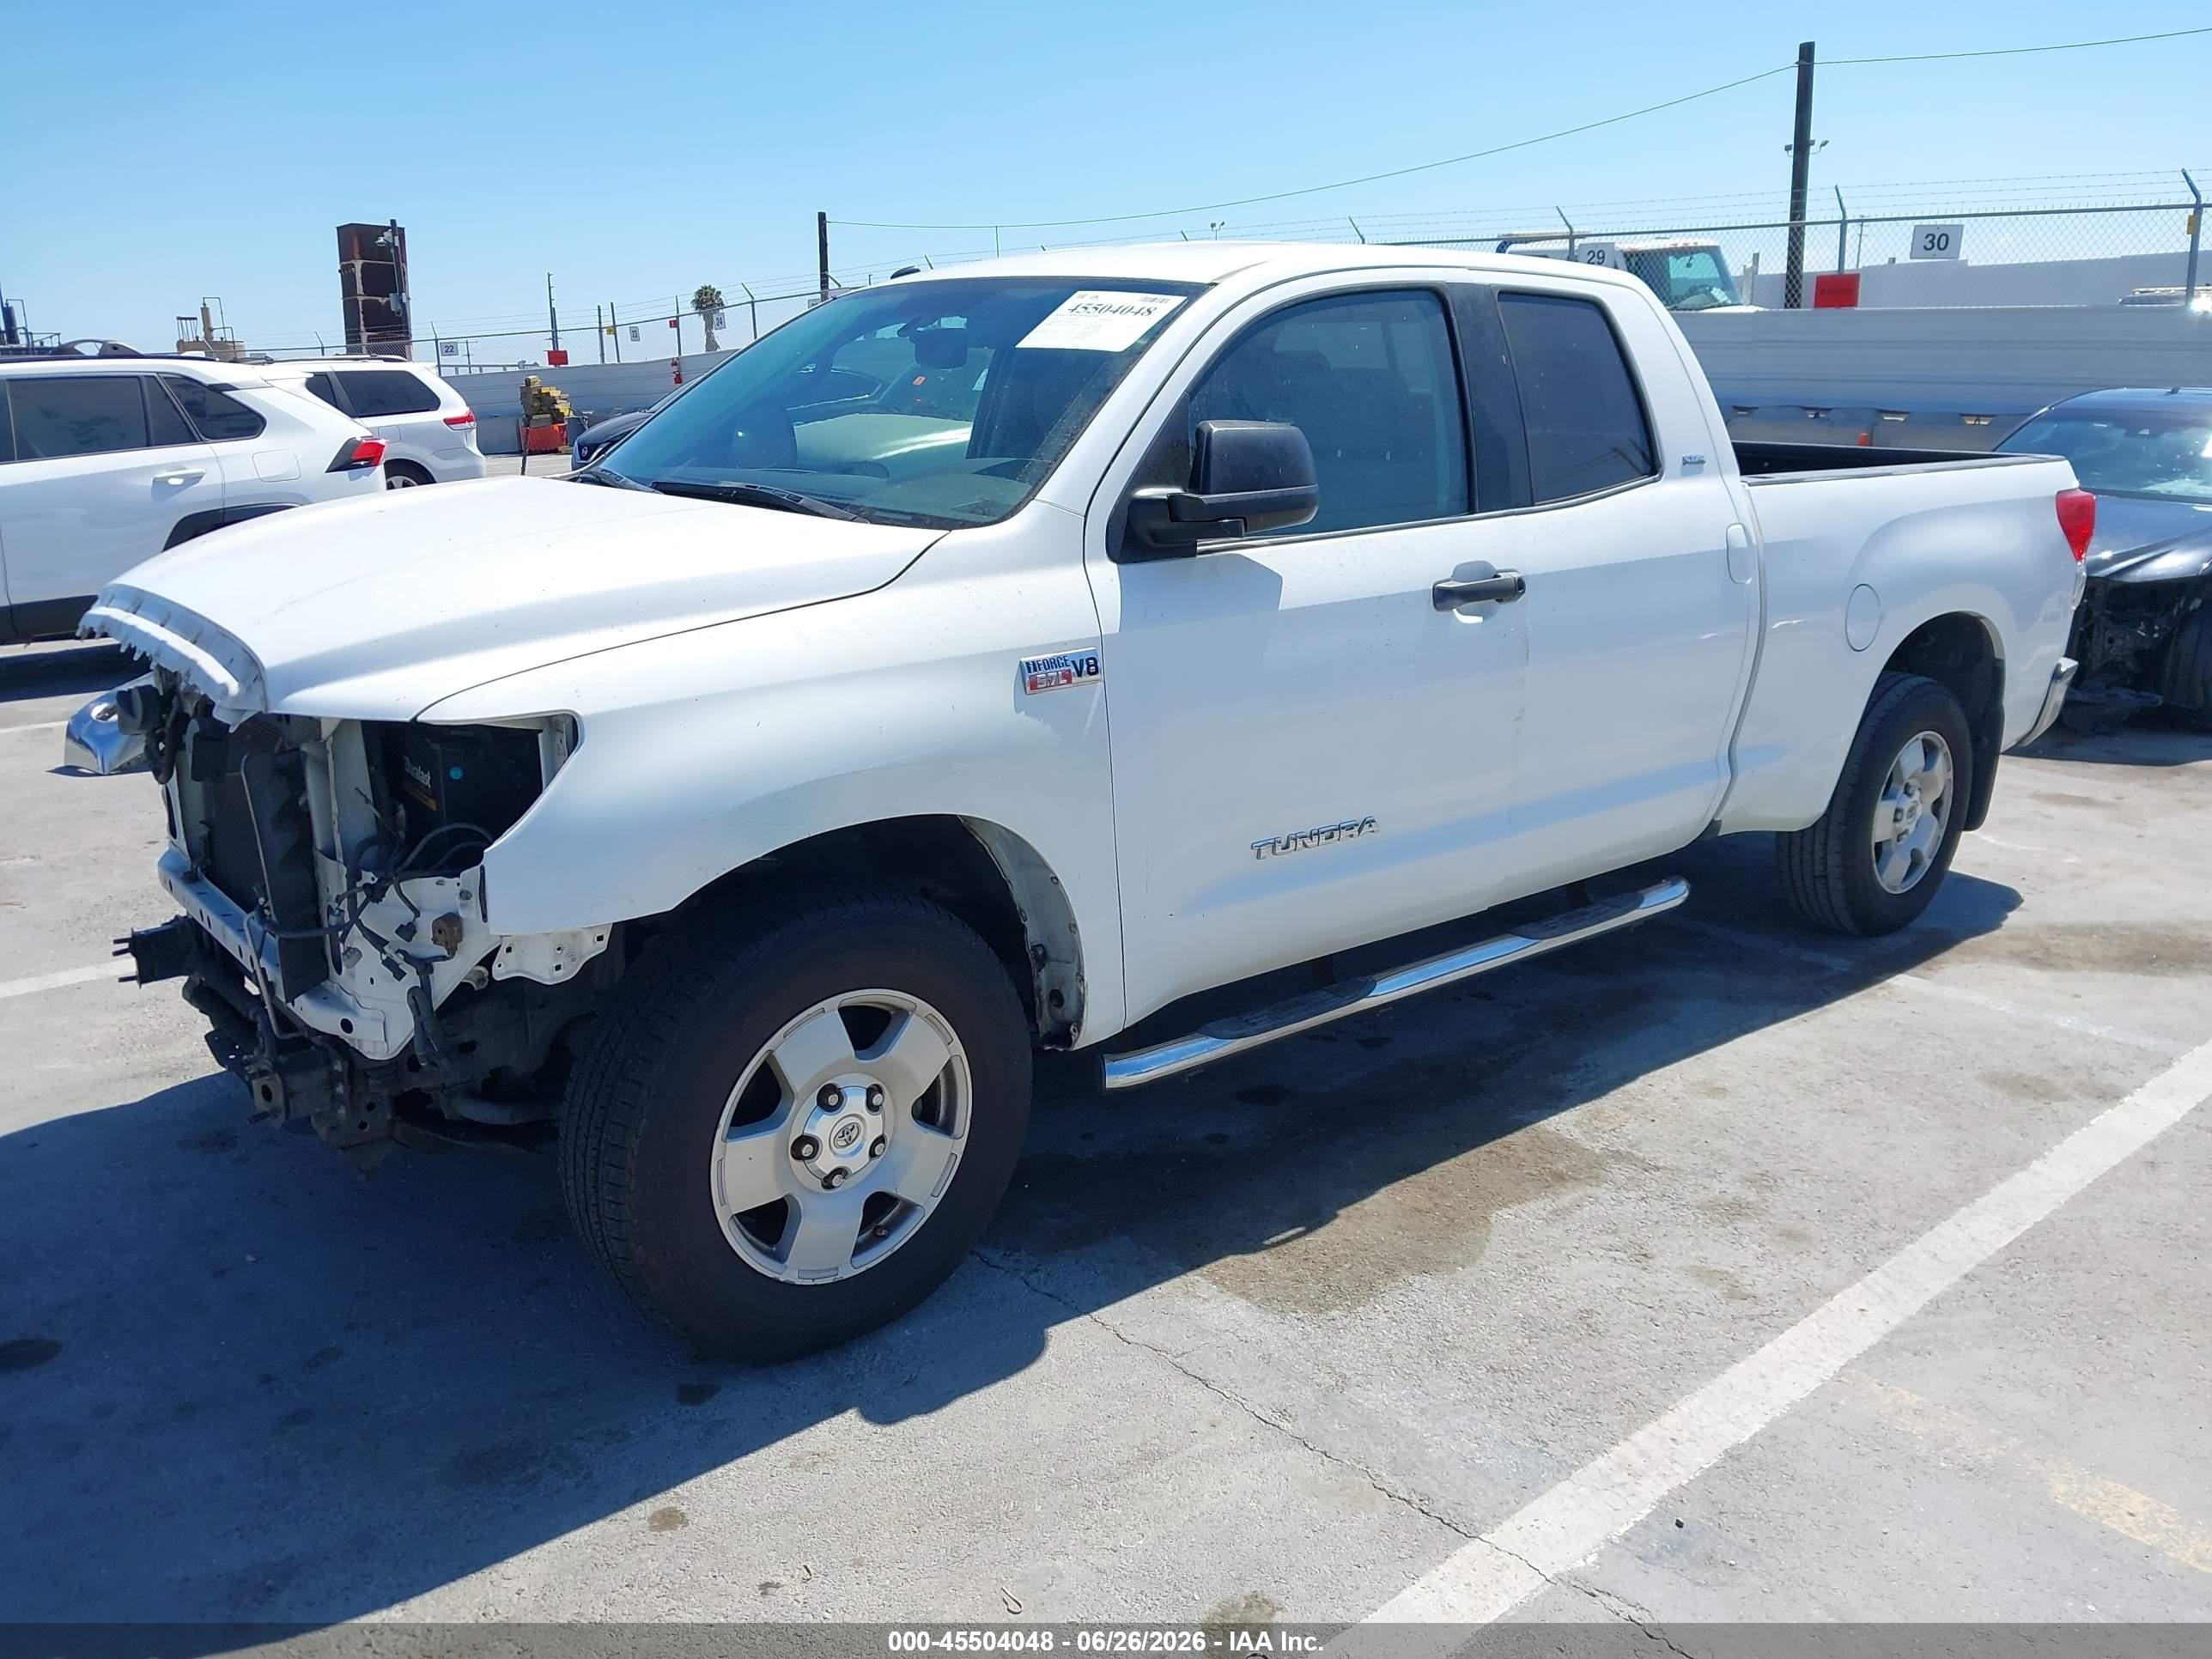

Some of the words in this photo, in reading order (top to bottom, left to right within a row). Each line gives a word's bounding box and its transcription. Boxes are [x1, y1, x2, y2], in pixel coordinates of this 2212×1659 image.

[1923, 233, 1949, 252] 30
[1587, 249, 1606, 265] 29
[1067, 302, 1158, 317] 45504048
[715, 317, 723, 326] 24
[444, 344, 454, 353] 22
[1071, 656, 1099, 678] V8
[1250, 816, 1380, 860] TUNDRA
